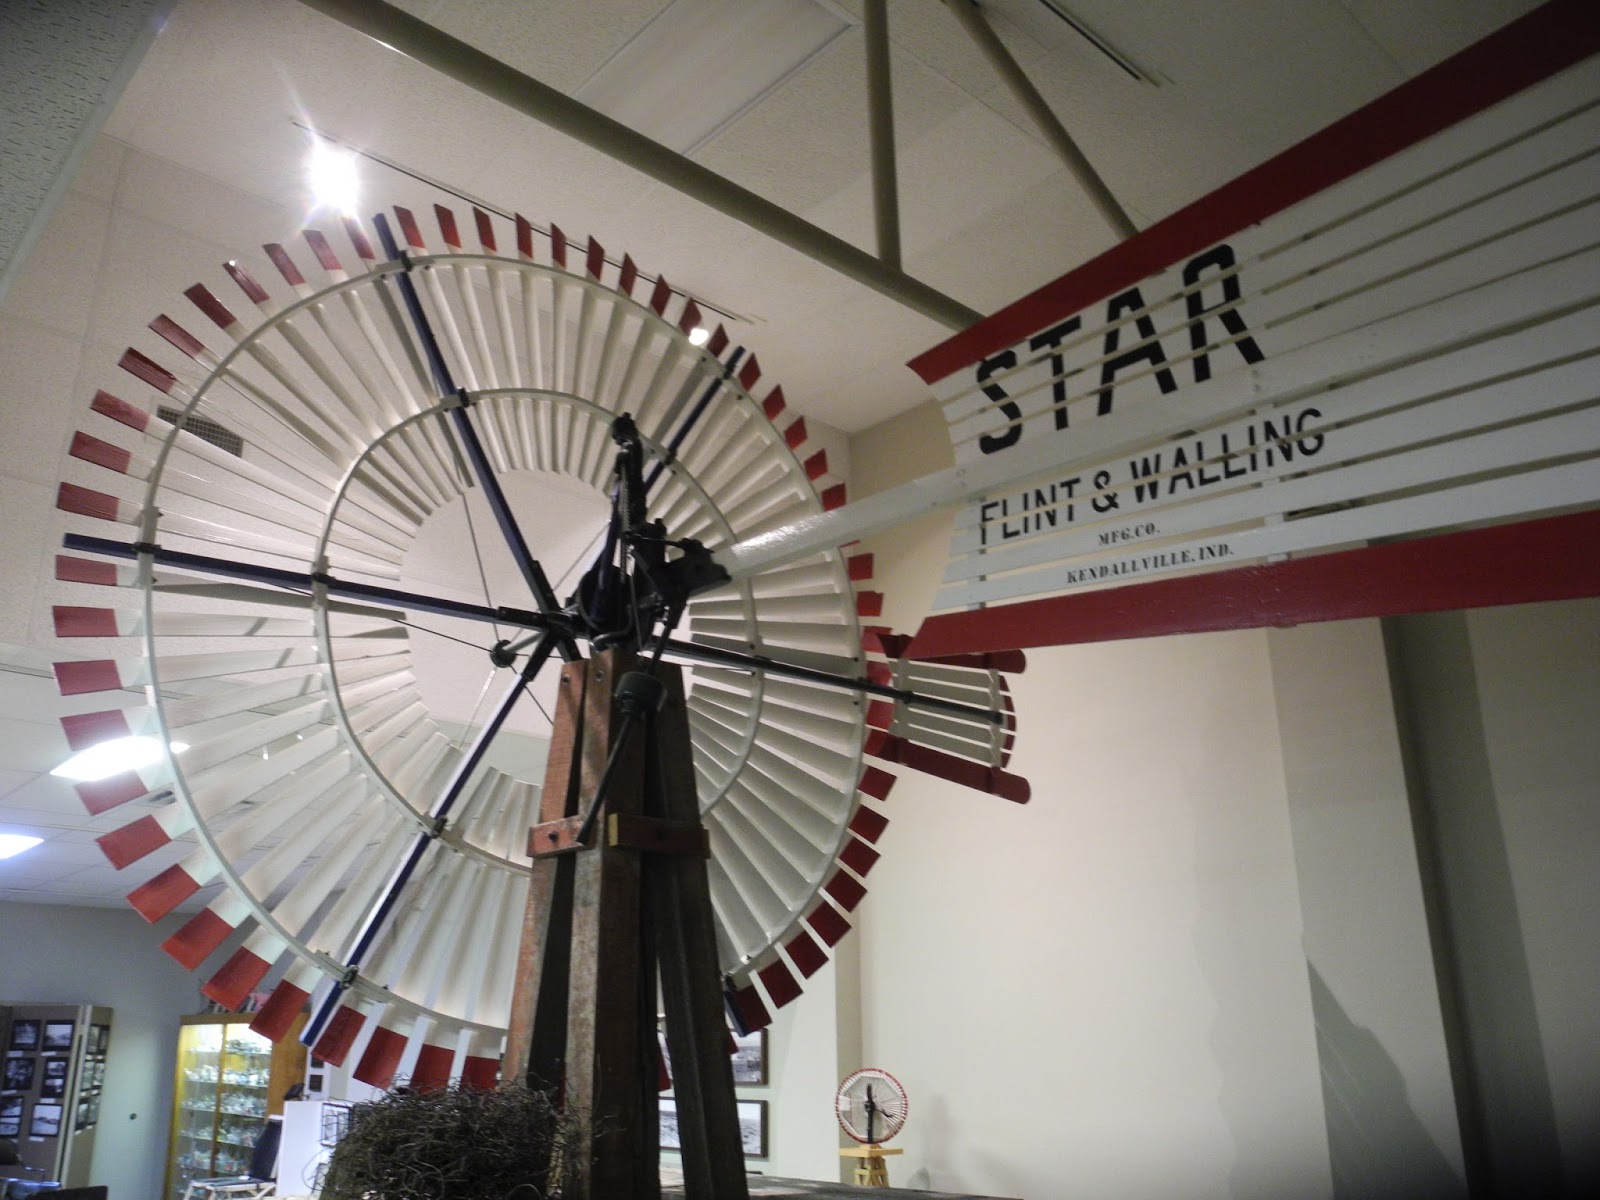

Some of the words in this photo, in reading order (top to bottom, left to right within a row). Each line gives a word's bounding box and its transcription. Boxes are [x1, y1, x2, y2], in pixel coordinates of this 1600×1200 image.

[975, 243, 1265, 455] STAR
[980, 477, 1081, 545] FLINT
[1091, 470, 1119, 513] &
[1130, 408, 1324, 503] WALLING
